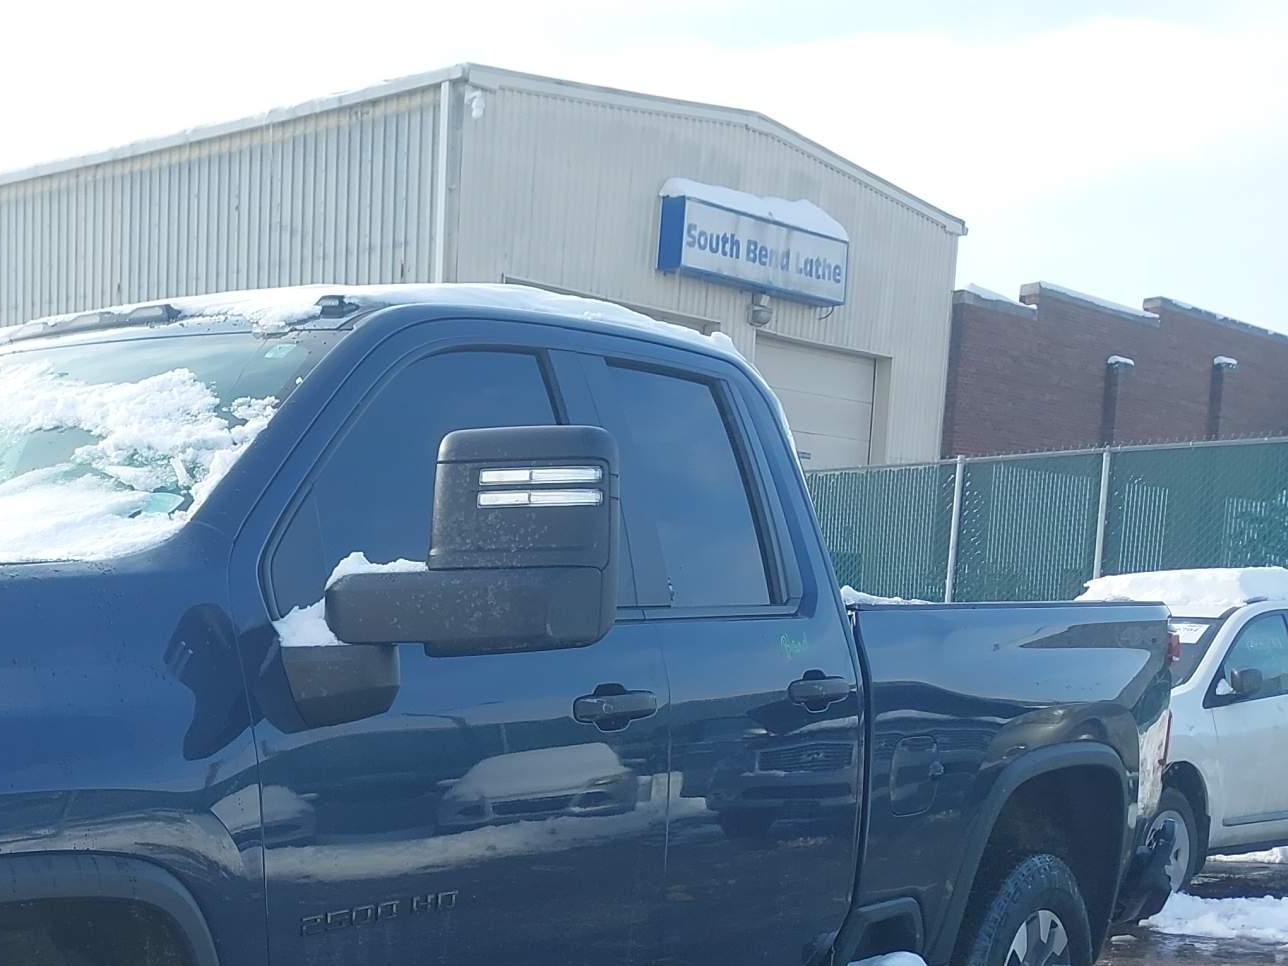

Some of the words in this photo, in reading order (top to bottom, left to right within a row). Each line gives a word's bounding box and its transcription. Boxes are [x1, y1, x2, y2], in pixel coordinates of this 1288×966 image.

[685, 223, 741, 260] South
[745, 238, 790, 271] Bend
[796, 251, 842, 284] Lathe
